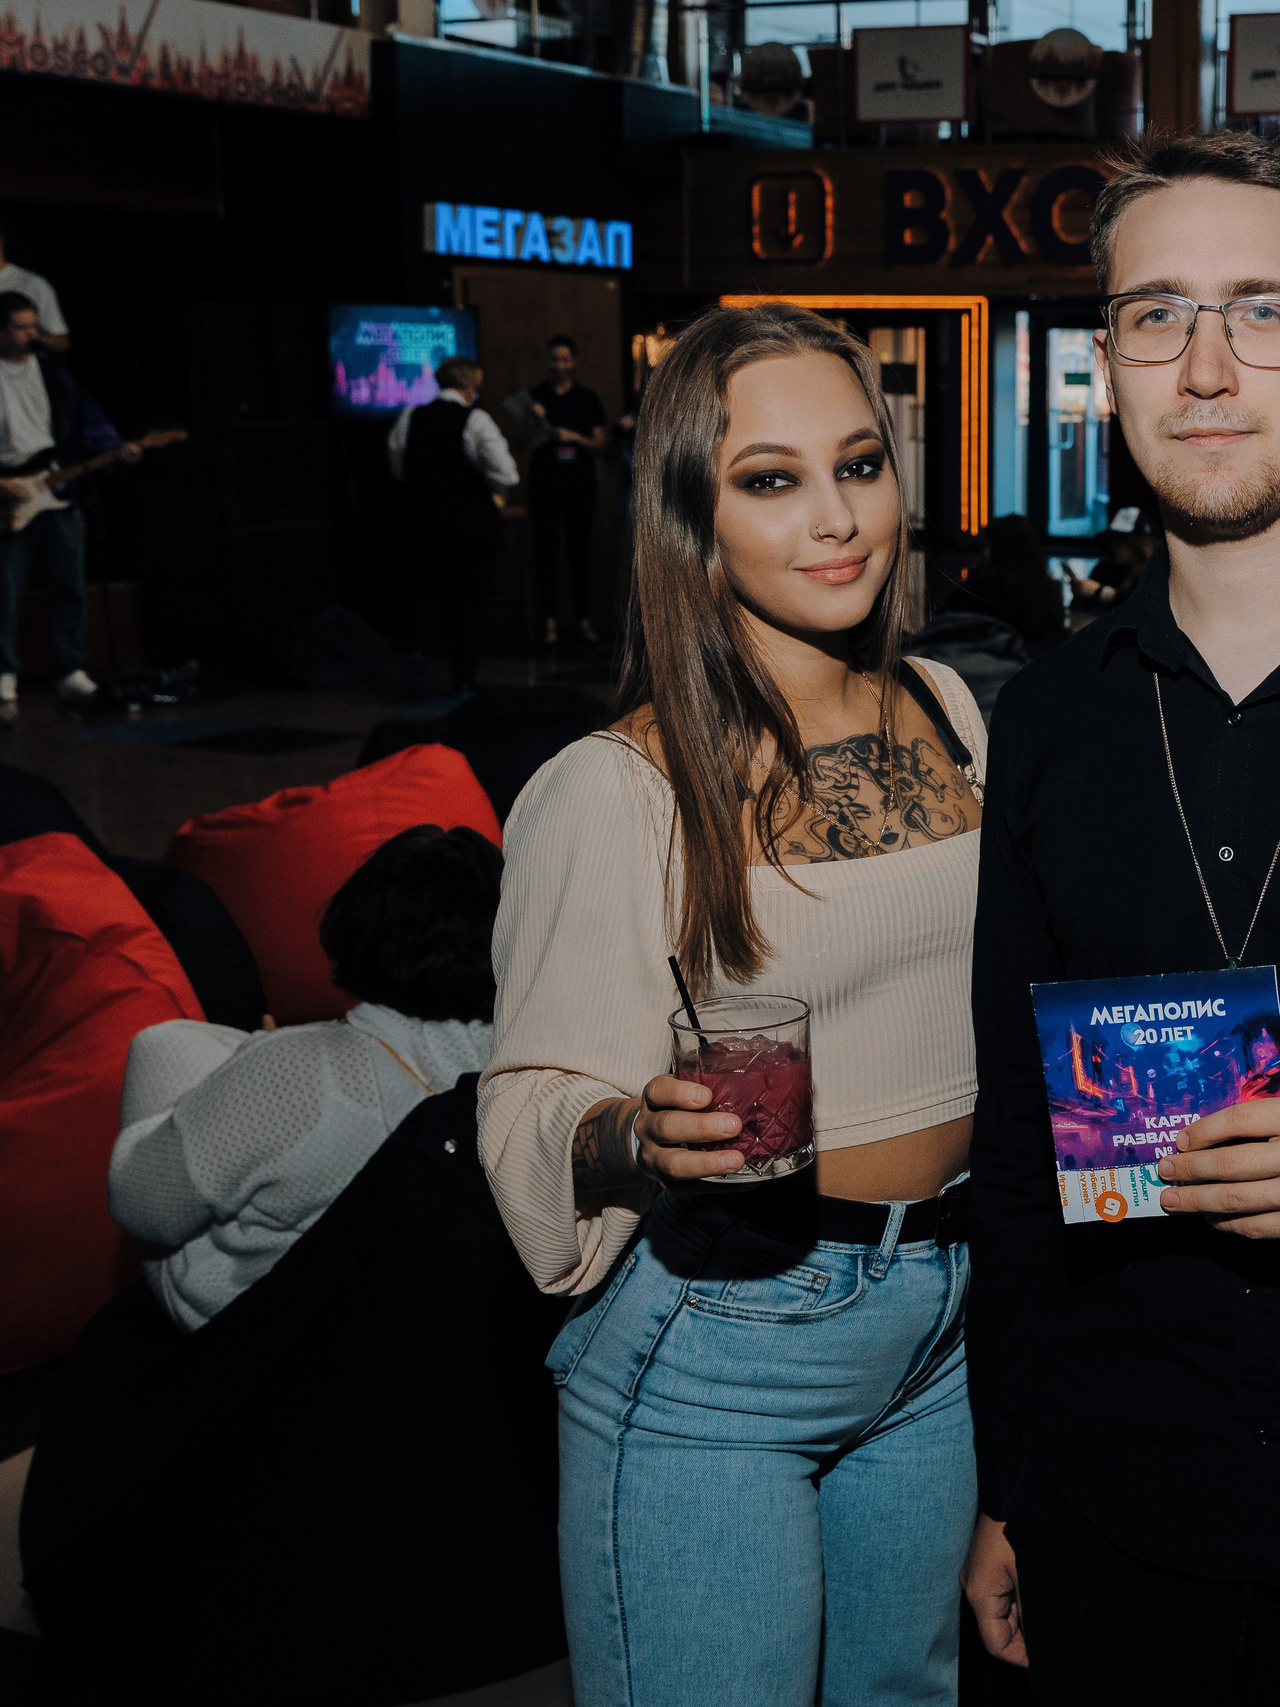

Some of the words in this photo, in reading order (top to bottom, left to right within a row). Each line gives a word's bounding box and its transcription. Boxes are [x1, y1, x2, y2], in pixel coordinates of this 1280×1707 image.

[432, 201, 634, 270] МЕГАЗАП
[1090, 998, 1227, 1026] МЕГАПОЛИС
[1133, 1028, 1158, 1045] 20
[1160, 1026, 1194, 1043] ЛЕТ
[1112, 1130, 1181, 1147] РАЗВЛЕ
[1080, 1171, 1091, 1204] кухней
[1129, 1169, 1140, 1207] напитки
